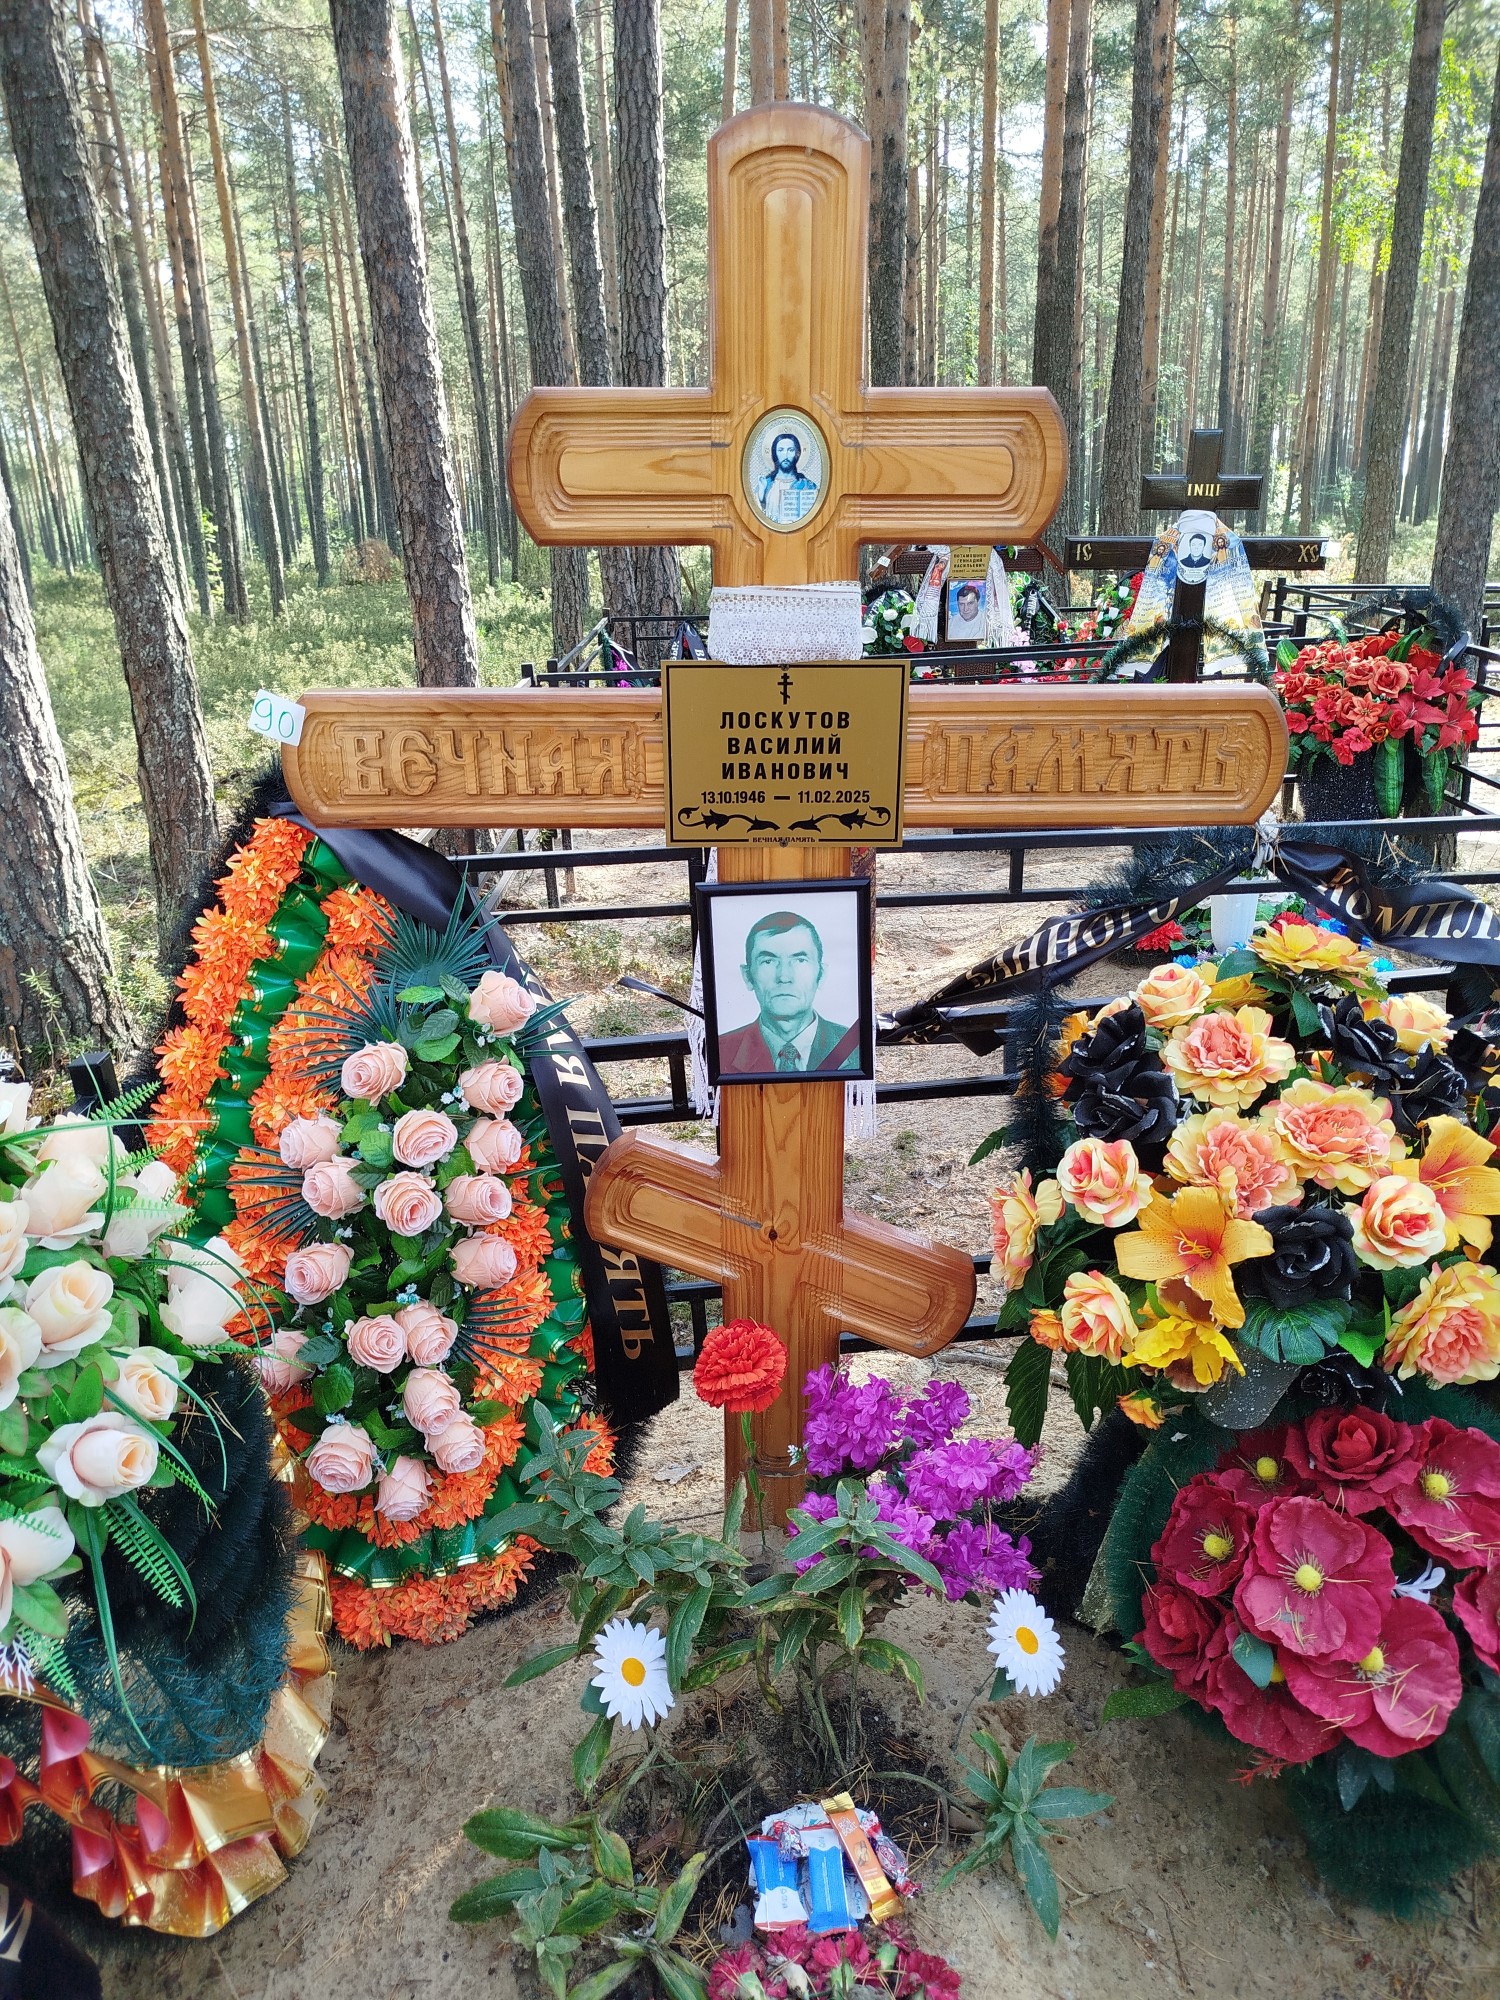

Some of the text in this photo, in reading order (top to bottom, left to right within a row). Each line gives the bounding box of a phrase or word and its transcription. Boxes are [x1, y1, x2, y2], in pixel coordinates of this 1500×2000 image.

[254, 698, 295, 738] 90
[719, 711, 850, 729] ЛОСКУТОВ
[727, 733, 841, 755] ВАСИЛИЙ
[939, 725, 1240, 794] ПАМЯТЬ
[721, 762, 849, 780] ИВАНОВИЧ
[701, 790, 766, 804] 13.10.1946
[797, 790, 871, 804] 11.02.2025
